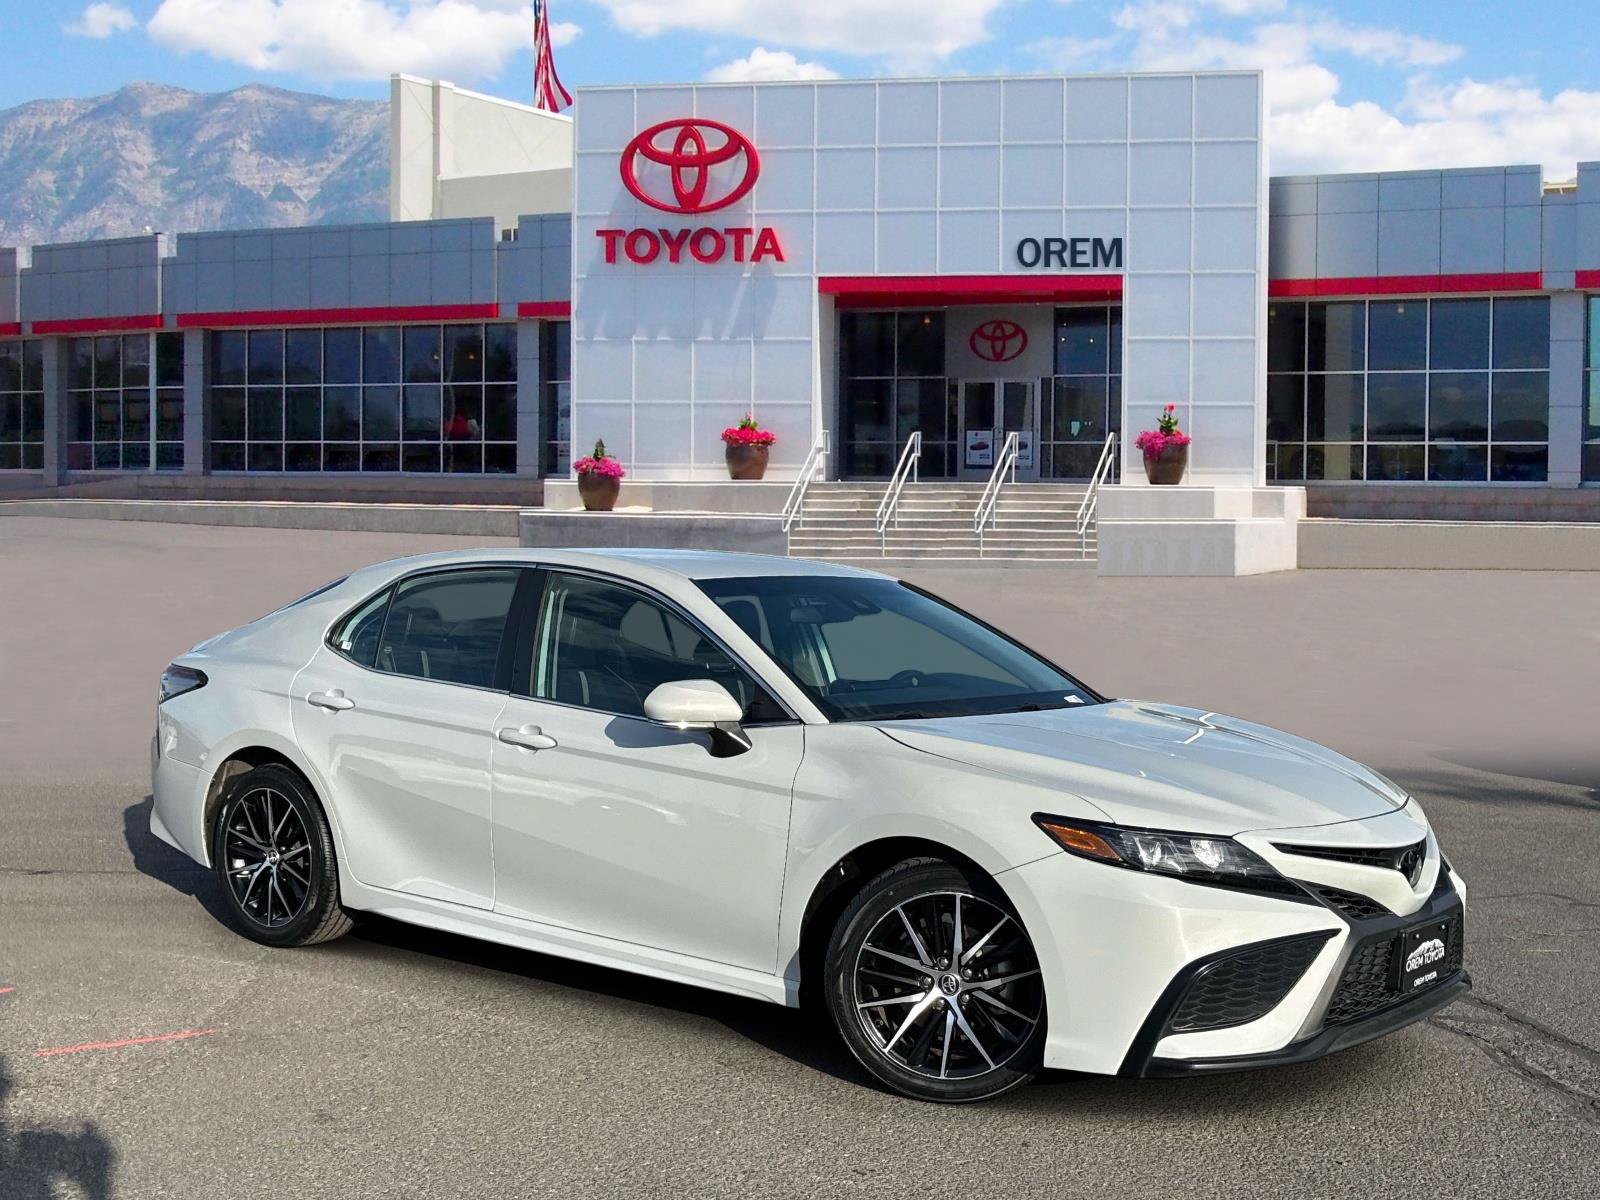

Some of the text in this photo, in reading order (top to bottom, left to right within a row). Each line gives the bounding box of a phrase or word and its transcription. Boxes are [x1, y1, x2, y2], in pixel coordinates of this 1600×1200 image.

[596, 228, 785, 264] TOYOTA
[1017, 238, 1123, 268] OREM
[1406, 947, 1444, 972] OREM TOYOTA
